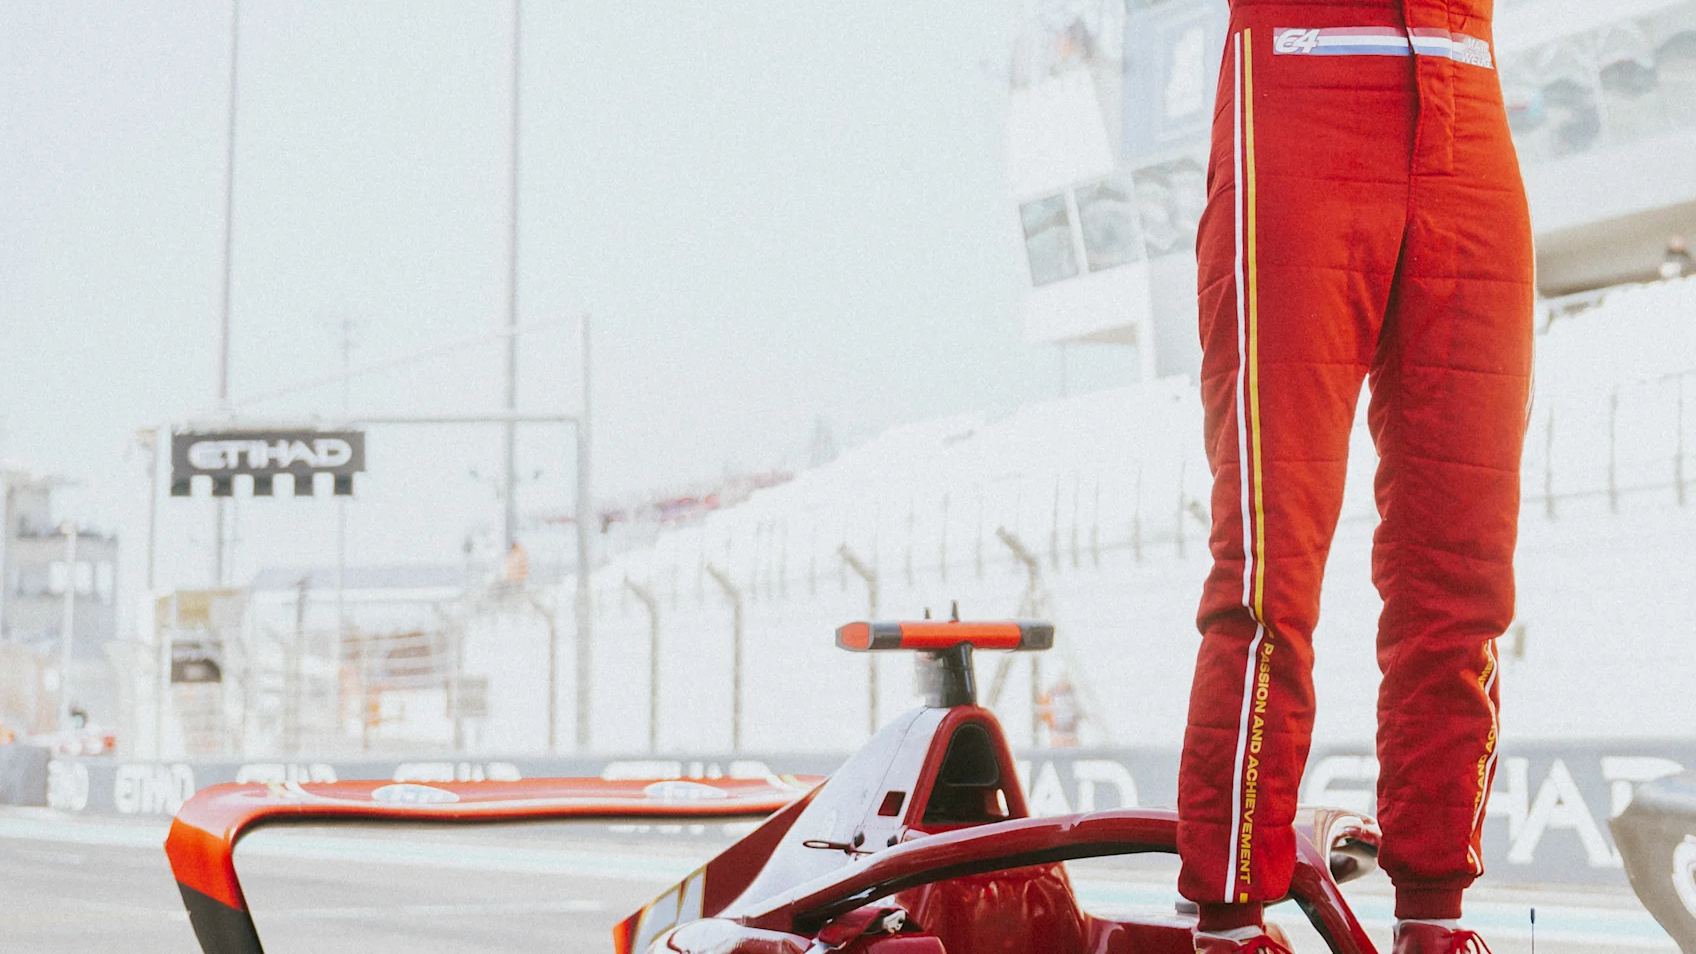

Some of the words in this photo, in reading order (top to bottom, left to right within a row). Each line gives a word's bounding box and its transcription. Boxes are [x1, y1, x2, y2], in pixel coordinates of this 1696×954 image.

[188, 438, 353, 470] ETIHAD
[1255, 642, 1275, 714] PASSION
[1250, 715, 1265, 754] AND
[1239, 754, 1260, 884] ACHIEVEMENT
